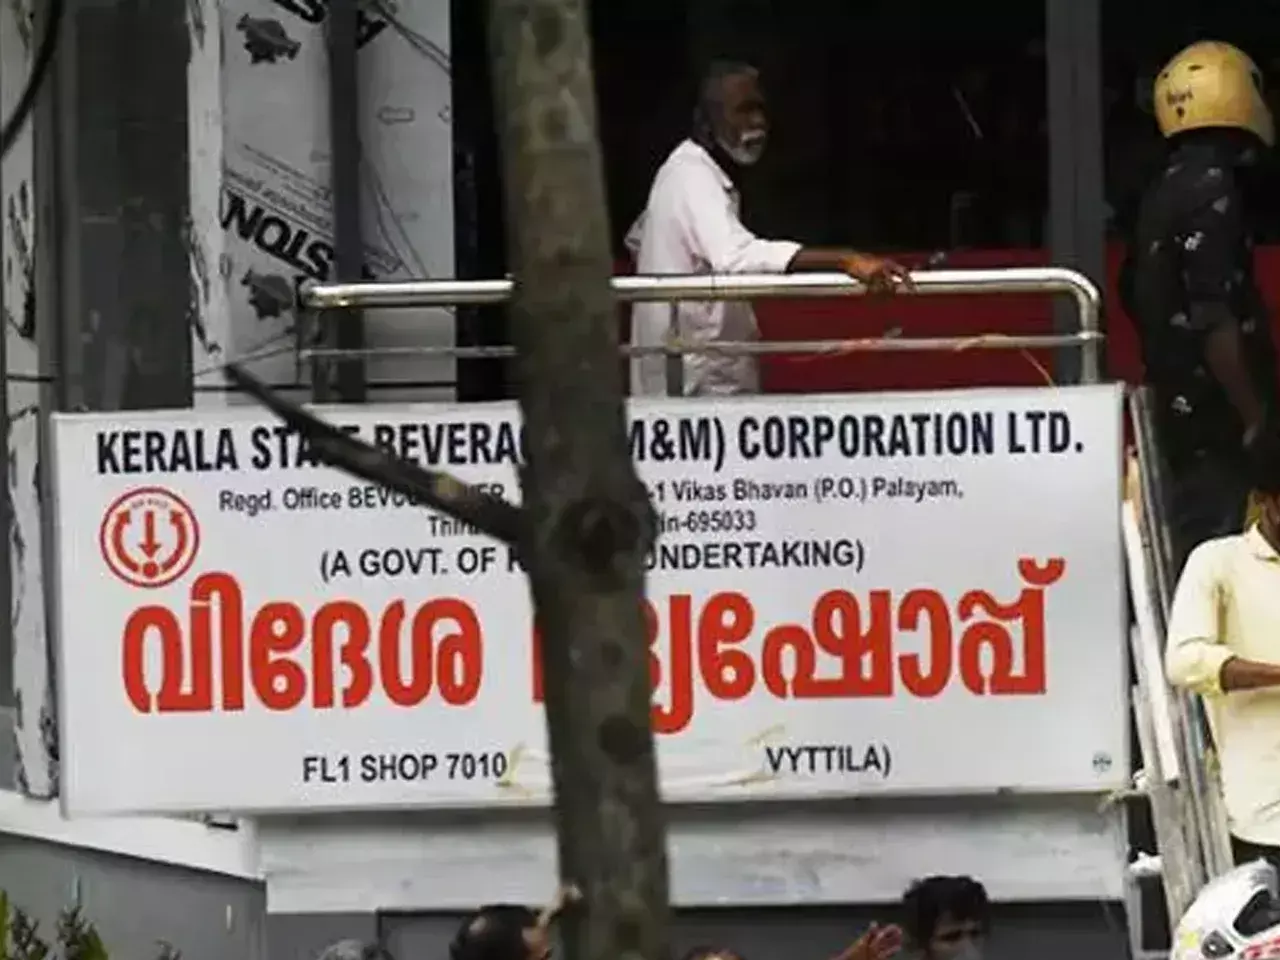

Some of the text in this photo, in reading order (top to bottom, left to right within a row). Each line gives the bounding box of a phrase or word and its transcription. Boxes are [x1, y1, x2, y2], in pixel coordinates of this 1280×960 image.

[96, 410, 1084, 475] KERALA STA BEVERA &M) CORPORATION LTD.
[218, 489, 278, 517] Regd.
[282, 486, 342, 510] Office
[347, 485, 421, 509] BEV
[671, 479, 728, 502] Vikas
[732, 477, 809, 502] Bhavan
[814, 475, 867, 504] (P.O.)
[872, 475, 965, 503] Palayam,
[659, 509, 757, 533] in-695033
[320, 549, 352, 583] (A
[358, 548, 449, 577] GOVT.
[456, 547, 497, 574] OF
[121, 570, 484, 715] വിദേശ
[302, 745, 892, 783] FL1 SHOP 7010 VYTTILA)
